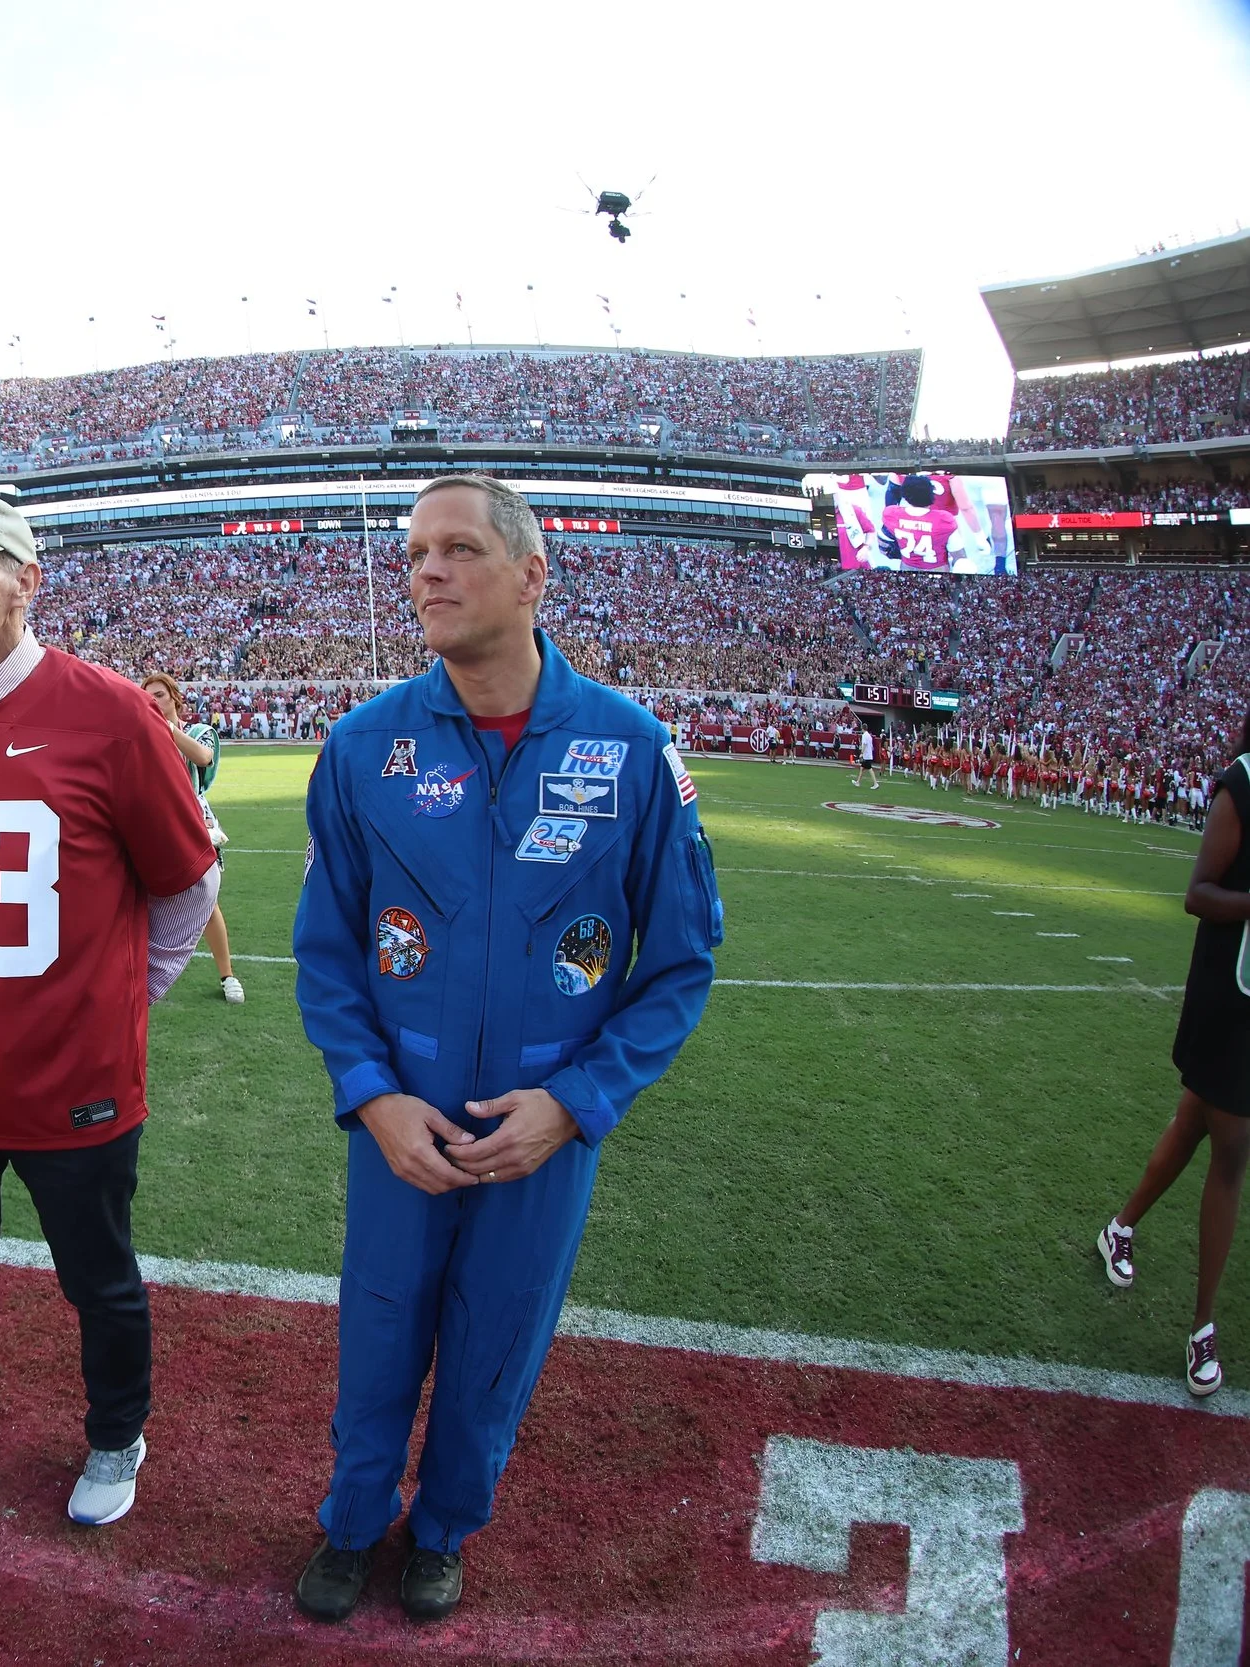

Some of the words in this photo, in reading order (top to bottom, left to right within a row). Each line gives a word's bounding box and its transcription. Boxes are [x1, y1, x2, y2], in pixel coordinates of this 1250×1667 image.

[280, 520, 290, 532] 0
[317, 519, 341, 530] DOWN
[367, 519, 377, 528] TO
[378, 519, 390, 528] GO
[598, 520, 607, 532] 0
[789, 535, 801, 546] 25
[894, 528, 937, 563] 74
[916, 692, 929, 705] 25
[751, 730, 769, 751] SEC
[382, 738, 418, 777] A
[563, 741, 624, 776] 100
[586, 755, 604, 763] DAYS
[416, 781, 464, 796] NASA
[559, 803, 575, 812] BOB
[578, 805, 599, 813] HINES
[525, 822, 577, 855] 25
[579, 919, 595, 939] 68
